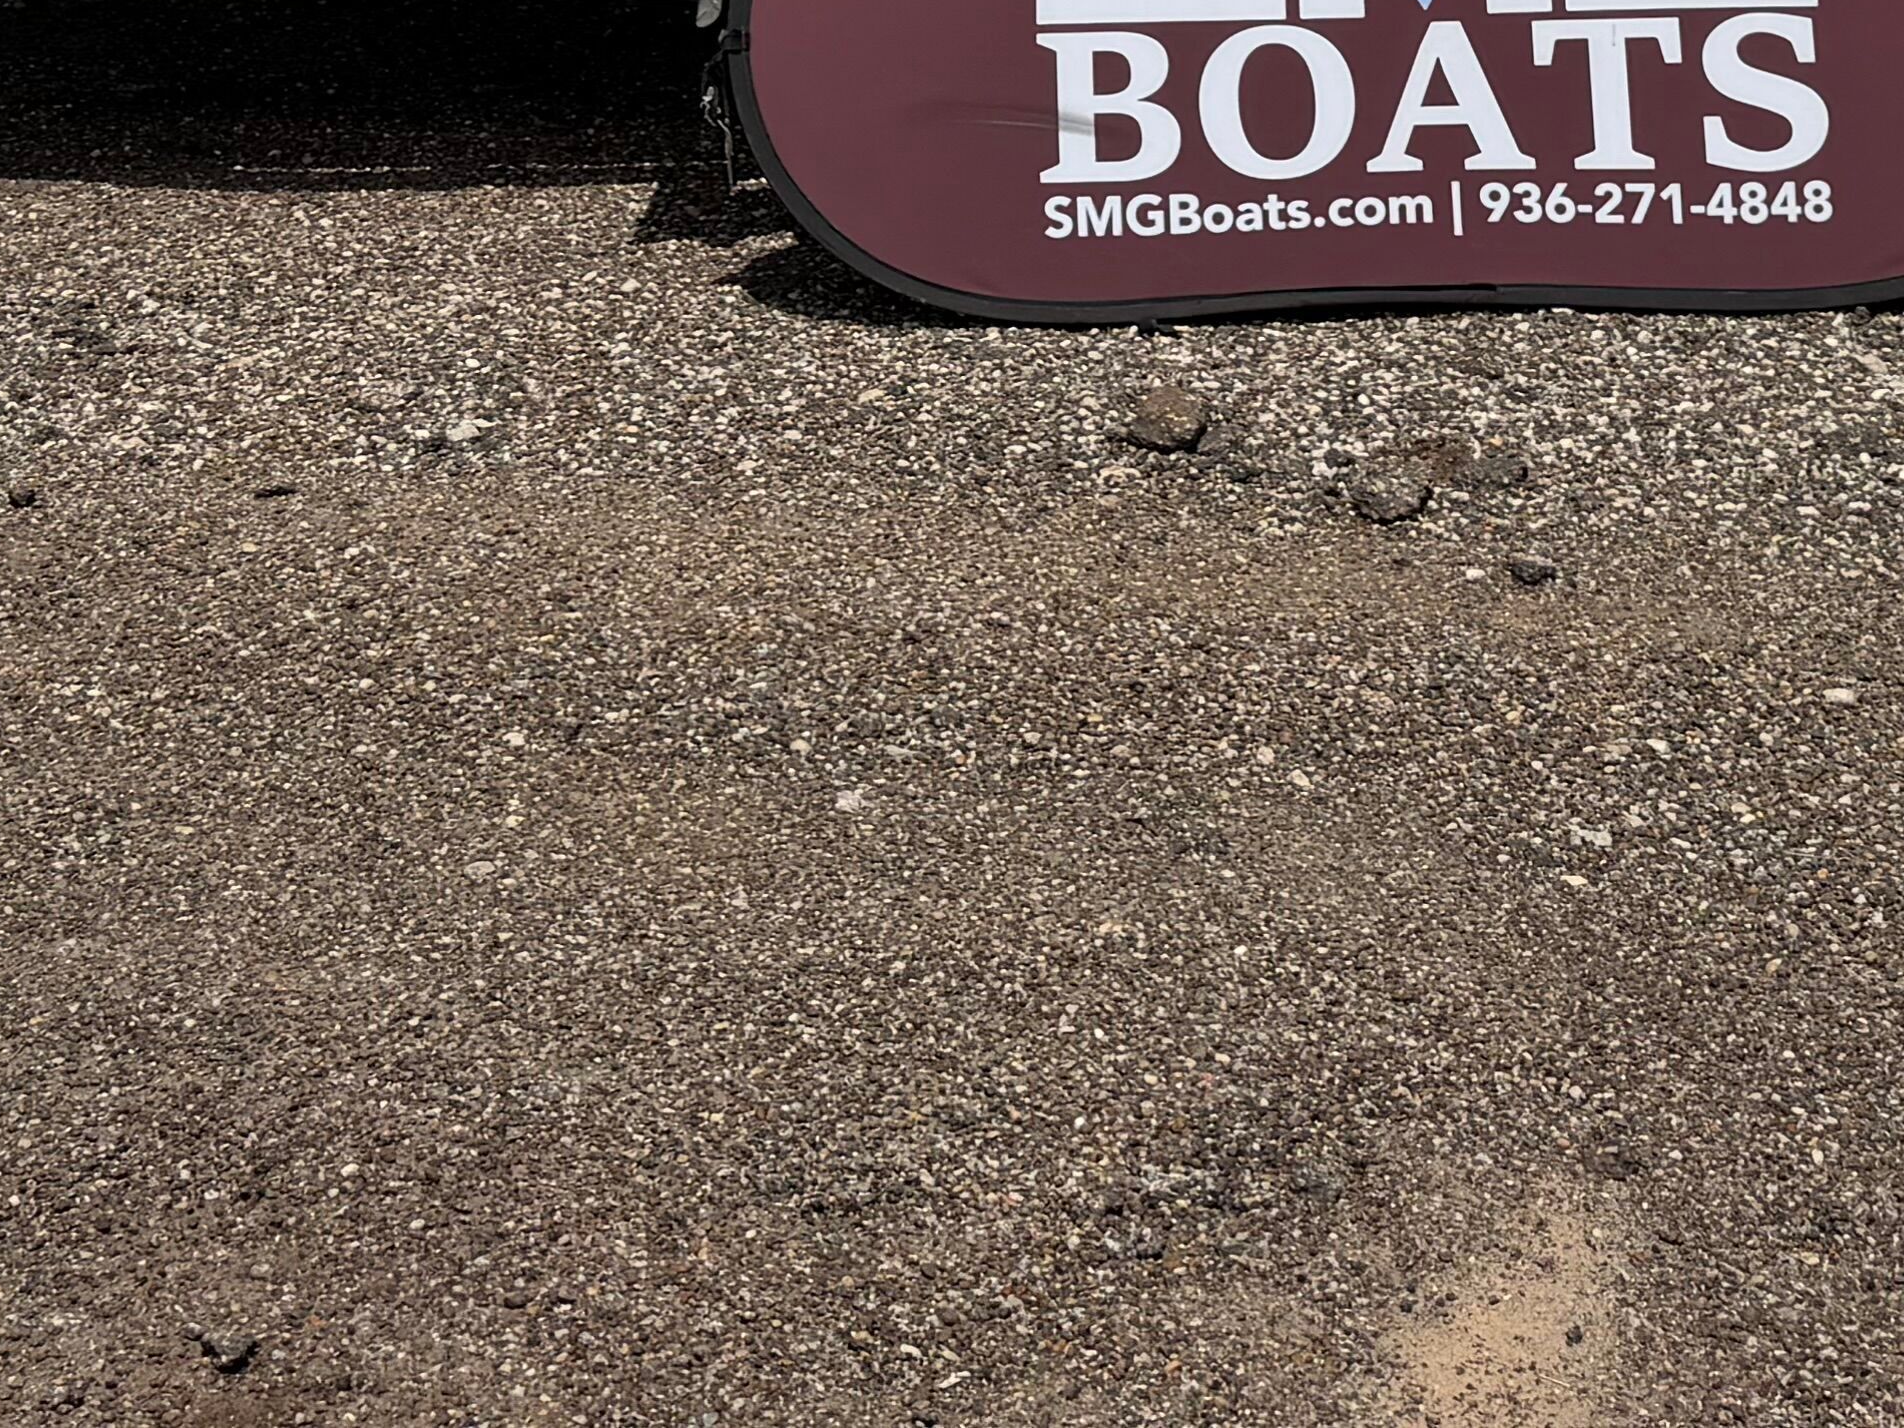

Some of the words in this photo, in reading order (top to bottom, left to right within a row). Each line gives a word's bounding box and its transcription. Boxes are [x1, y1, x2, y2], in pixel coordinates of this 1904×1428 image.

[1036, 12, 1831, 184] BOATS
[1043, 187, 1434, 238] SMGBoats.com
[1479, 177, 1834, 225] 936-271-4848
